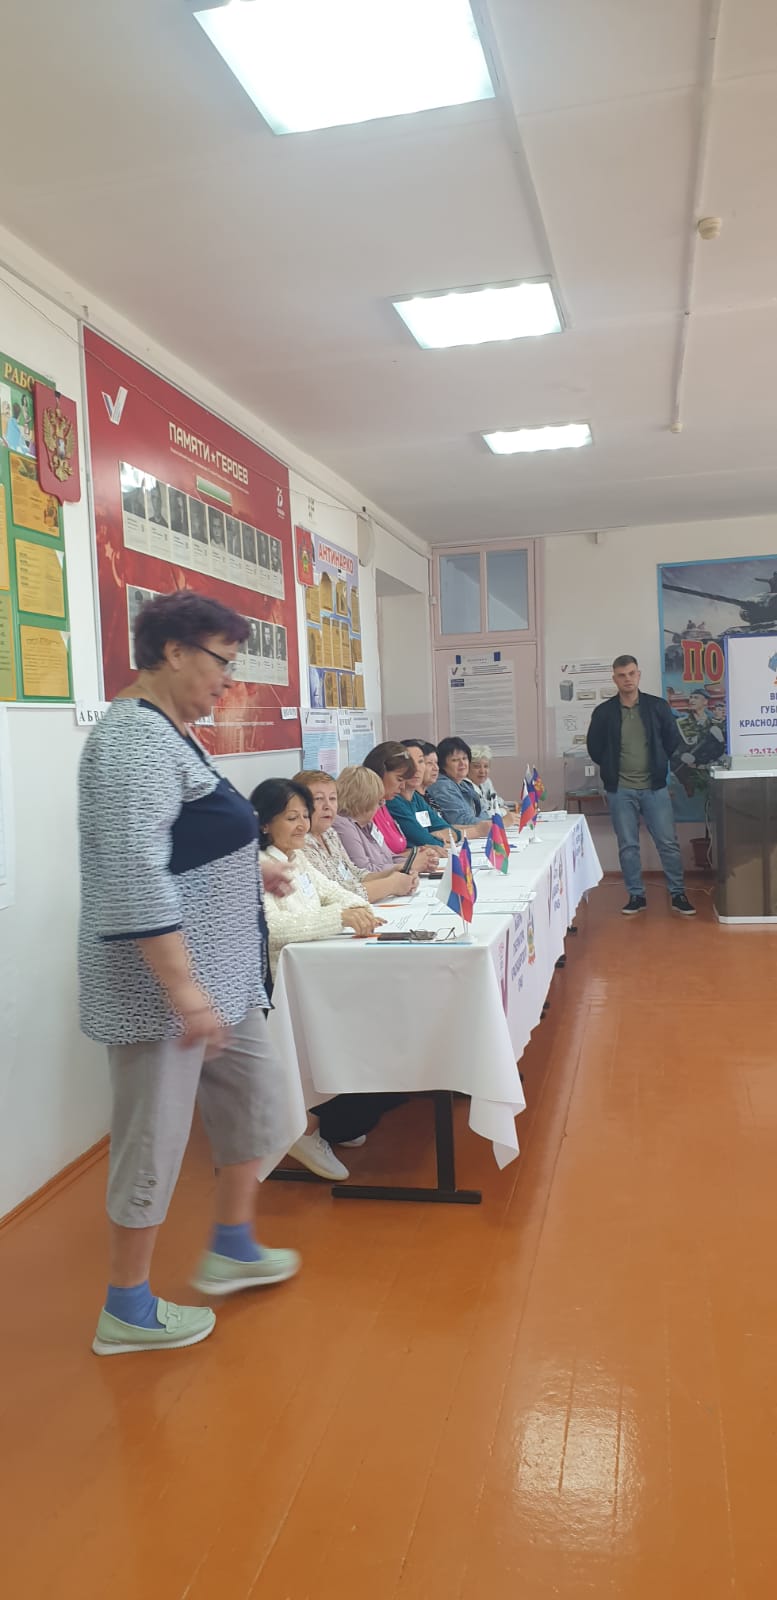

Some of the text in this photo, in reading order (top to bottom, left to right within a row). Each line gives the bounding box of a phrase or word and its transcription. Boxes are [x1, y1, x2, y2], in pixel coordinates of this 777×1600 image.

[4, 362, 36, 392] РАБО
[168, 421, 210, 462] ПАМЯТИ
[216, 451, 249, 485] ГЕРОЕВ
[681, 640, 724, 683] ПО
[769, 692, 777, 701] В
[760, 705, 777, 714] ГУБ
[739, 719, 777, 729] КРАСНОД
